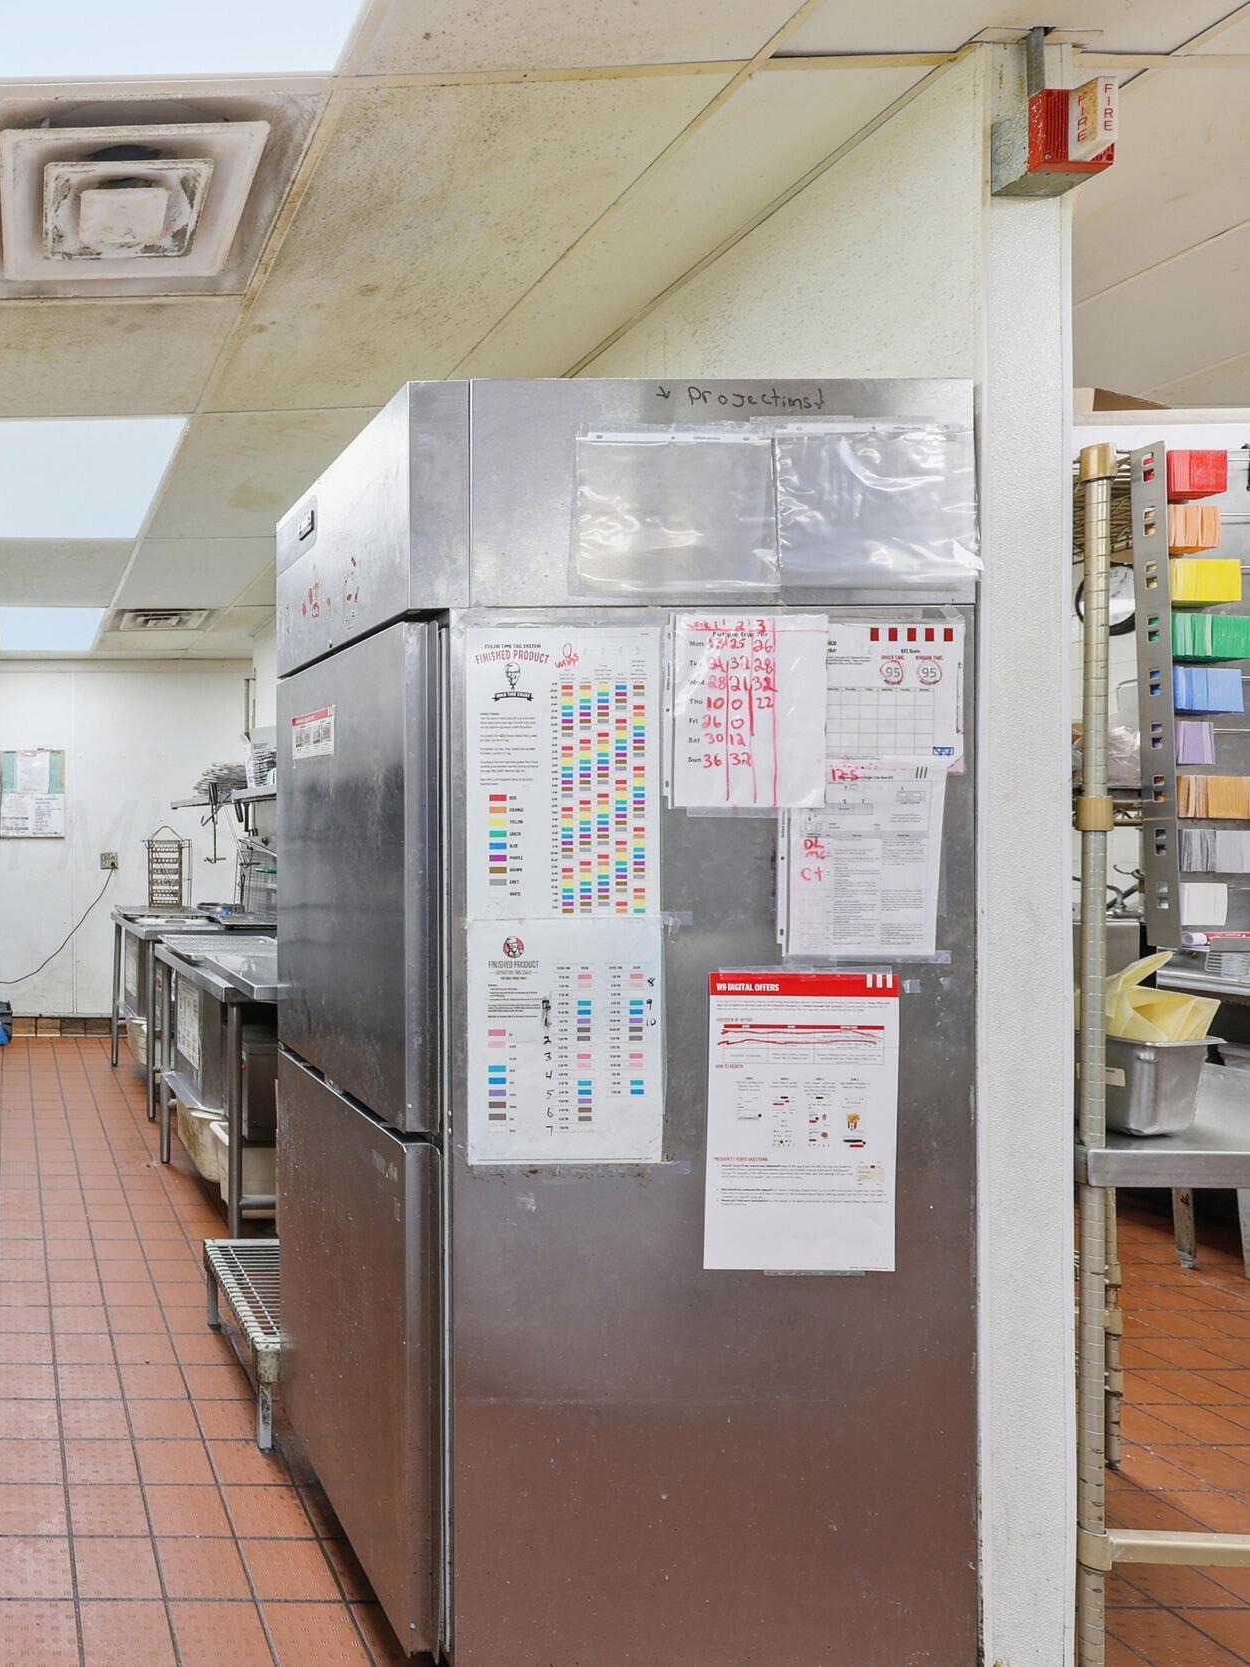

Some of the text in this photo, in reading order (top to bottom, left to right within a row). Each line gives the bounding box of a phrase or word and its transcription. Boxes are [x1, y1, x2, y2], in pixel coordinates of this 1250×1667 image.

[1104, 83, 1114, 131] FIRE
[1077, 92, 1088, 144] FIRE
[756, 619, 766, 634] 3
[730, 638, 773, 653] 25 26
[474, 650, 550, 665] FINISHED PRODUCT
[753, 658, 773, 674] 28
[885, 667, 900, 678] 95
[921, 667, 937, 678] 95
[707, 675, 726, 690] 28
[706, 696, 774, 710] 10 0 22
[701, 714, 745, 730] 26 0
[704, 733, 746, 747] 30 12
[702, 753, 723, 769] 36
[488, 960, 539, 968] FINISHED PRODUCT
[728, 983, 753, 991] DIGITAL
[754, 983, 780, 992] OFFERS
[543, 1035, 552, 1045] 2
[543, 1052, 552, 1061] 3
[545, 1069, 553, 1080] 4
[546, 1089, 555, 1099] 5
[547, 1107, 554, 1118] 6
[545, 1125, 553, 1136] 7
